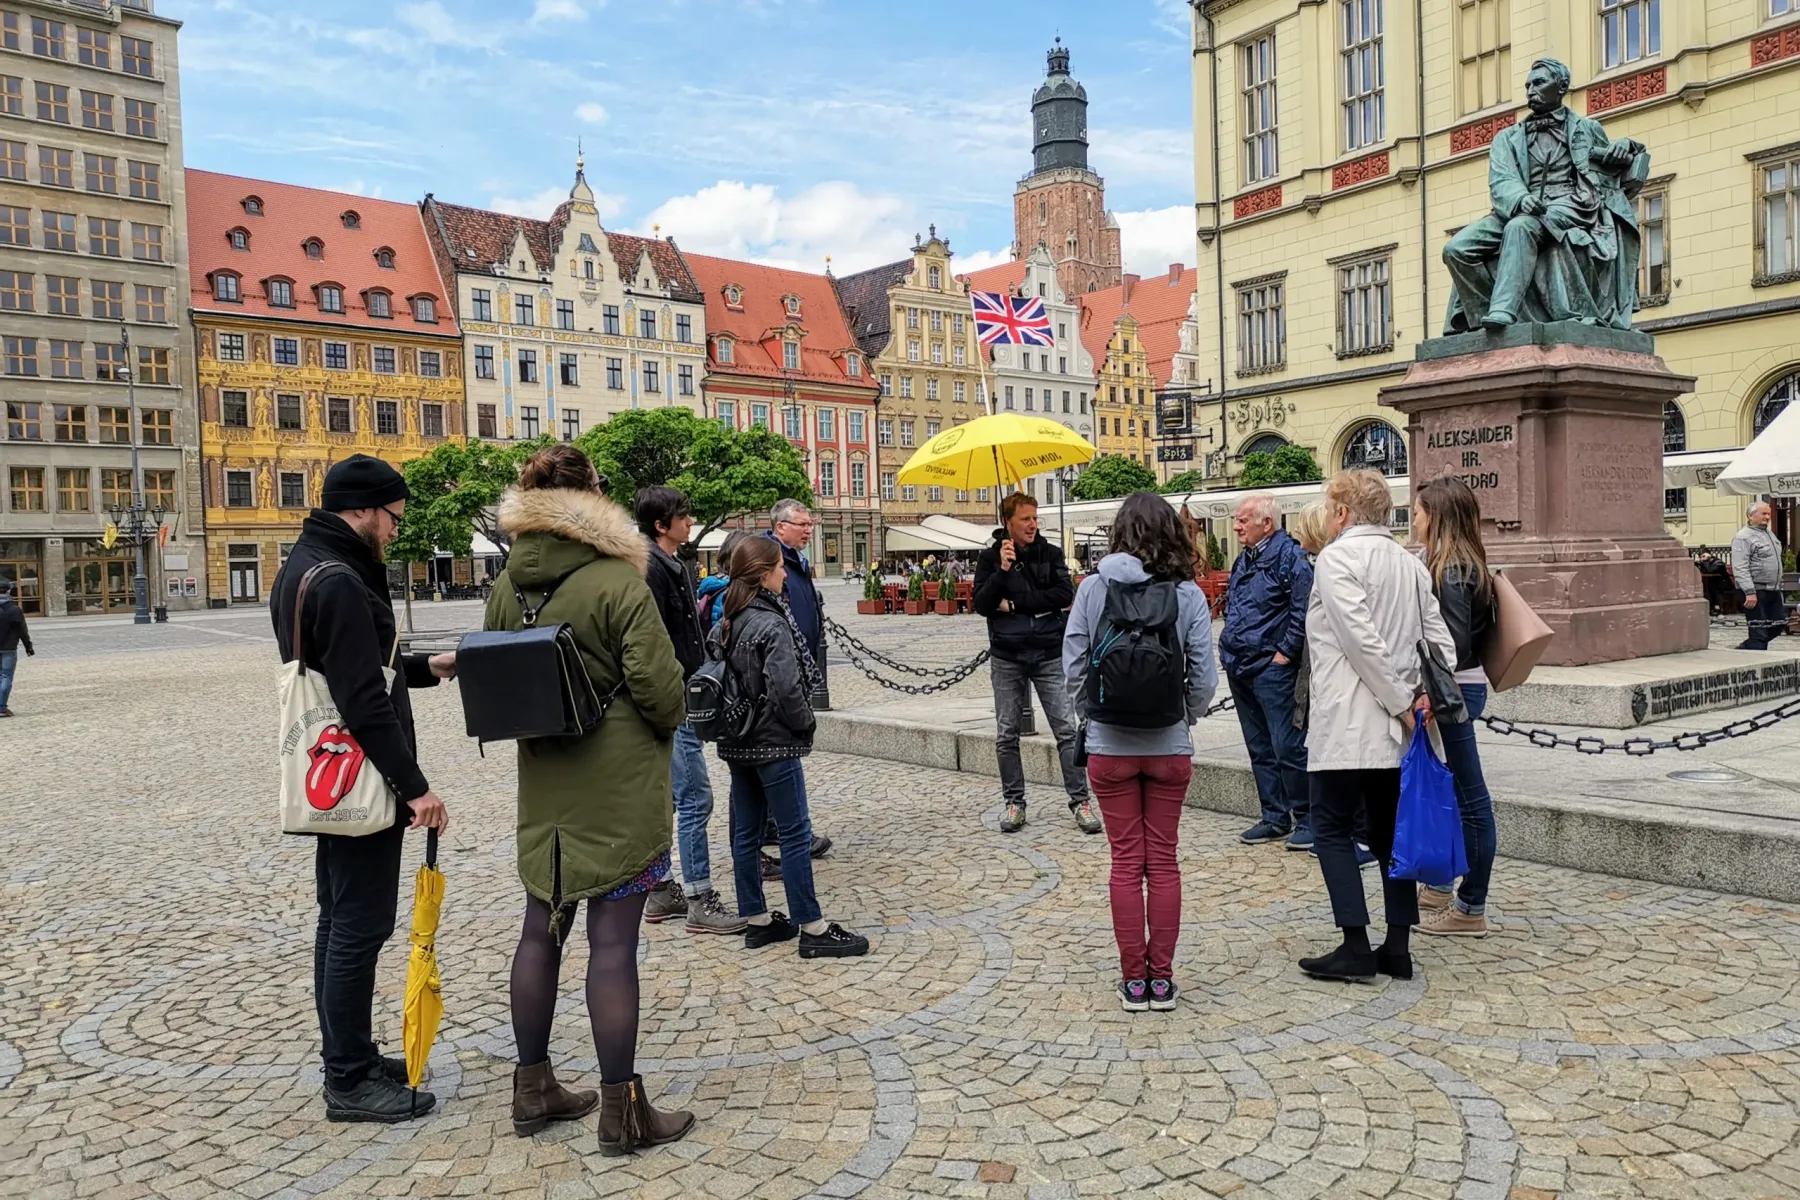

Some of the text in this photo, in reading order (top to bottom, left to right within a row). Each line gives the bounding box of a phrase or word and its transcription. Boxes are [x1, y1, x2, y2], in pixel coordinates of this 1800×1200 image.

[1427, 425, 1513, 449] ALEKSANDER
[1461, 451, 1482, 467] HR.
[1456, 473, 1499, 489] EDRO
[1704, 471, 1719, 480] Spi
[281, 707, 342, 756] THE ROLLIN
